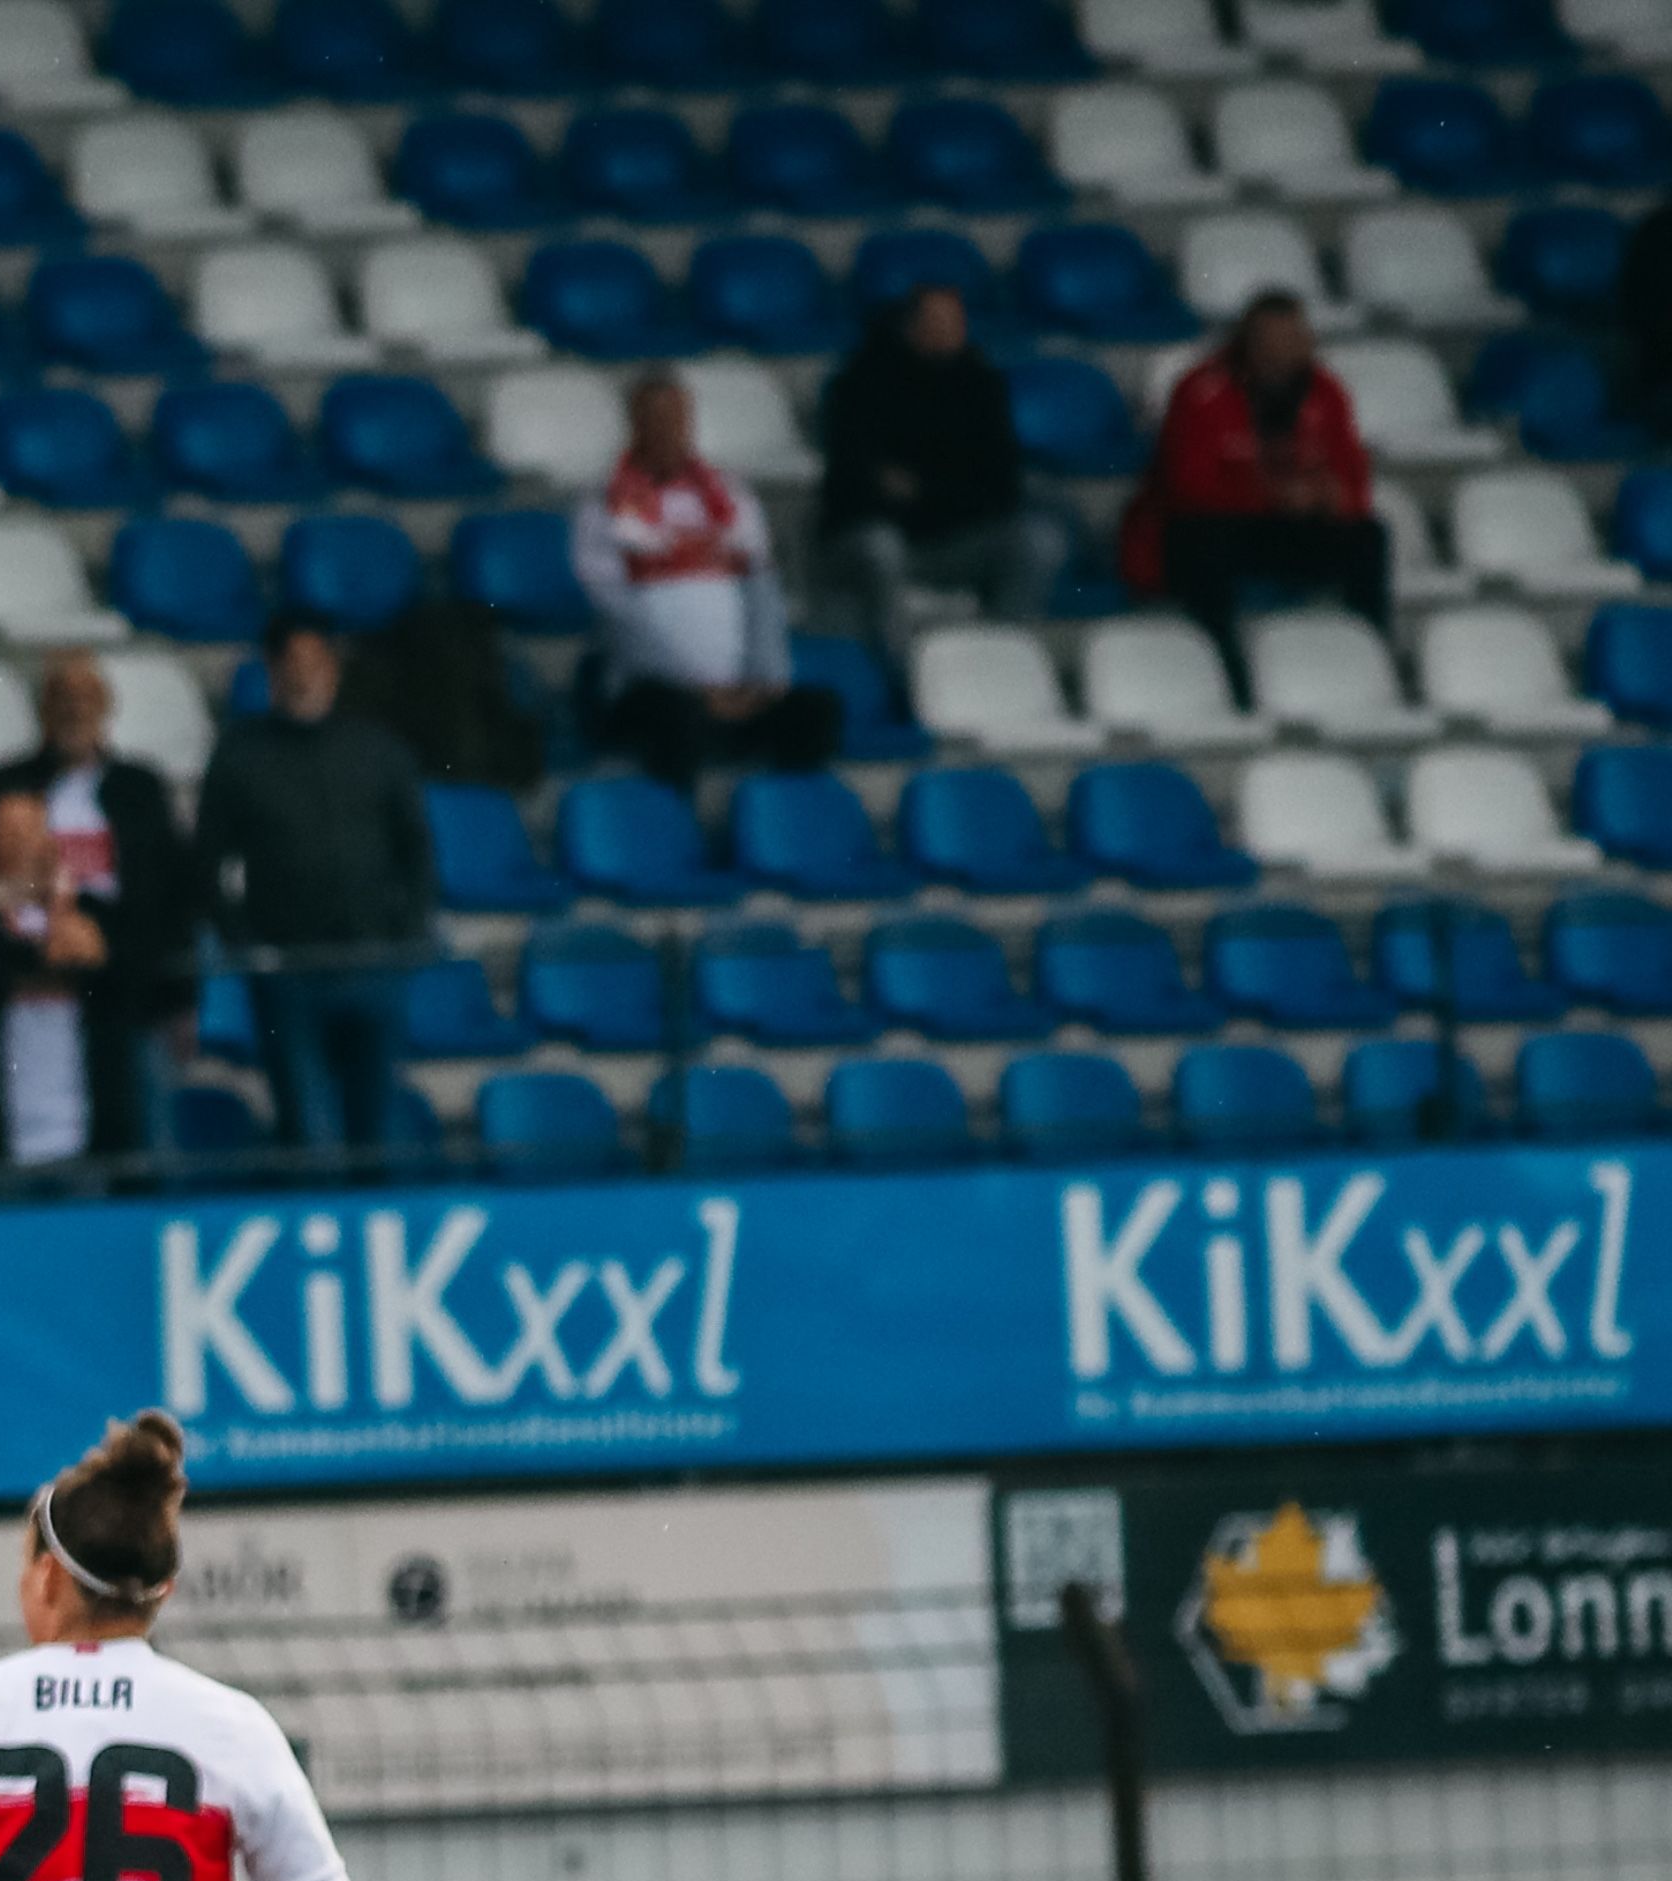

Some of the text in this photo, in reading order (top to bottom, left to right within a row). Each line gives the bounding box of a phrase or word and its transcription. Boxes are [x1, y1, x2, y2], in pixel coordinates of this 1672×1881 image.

[158, 1195, 739, 1415] KiKxxl
[1059, 1160, 1632, 1378] KiKxxl
[34, 1676, 134, 1712] BILLA
